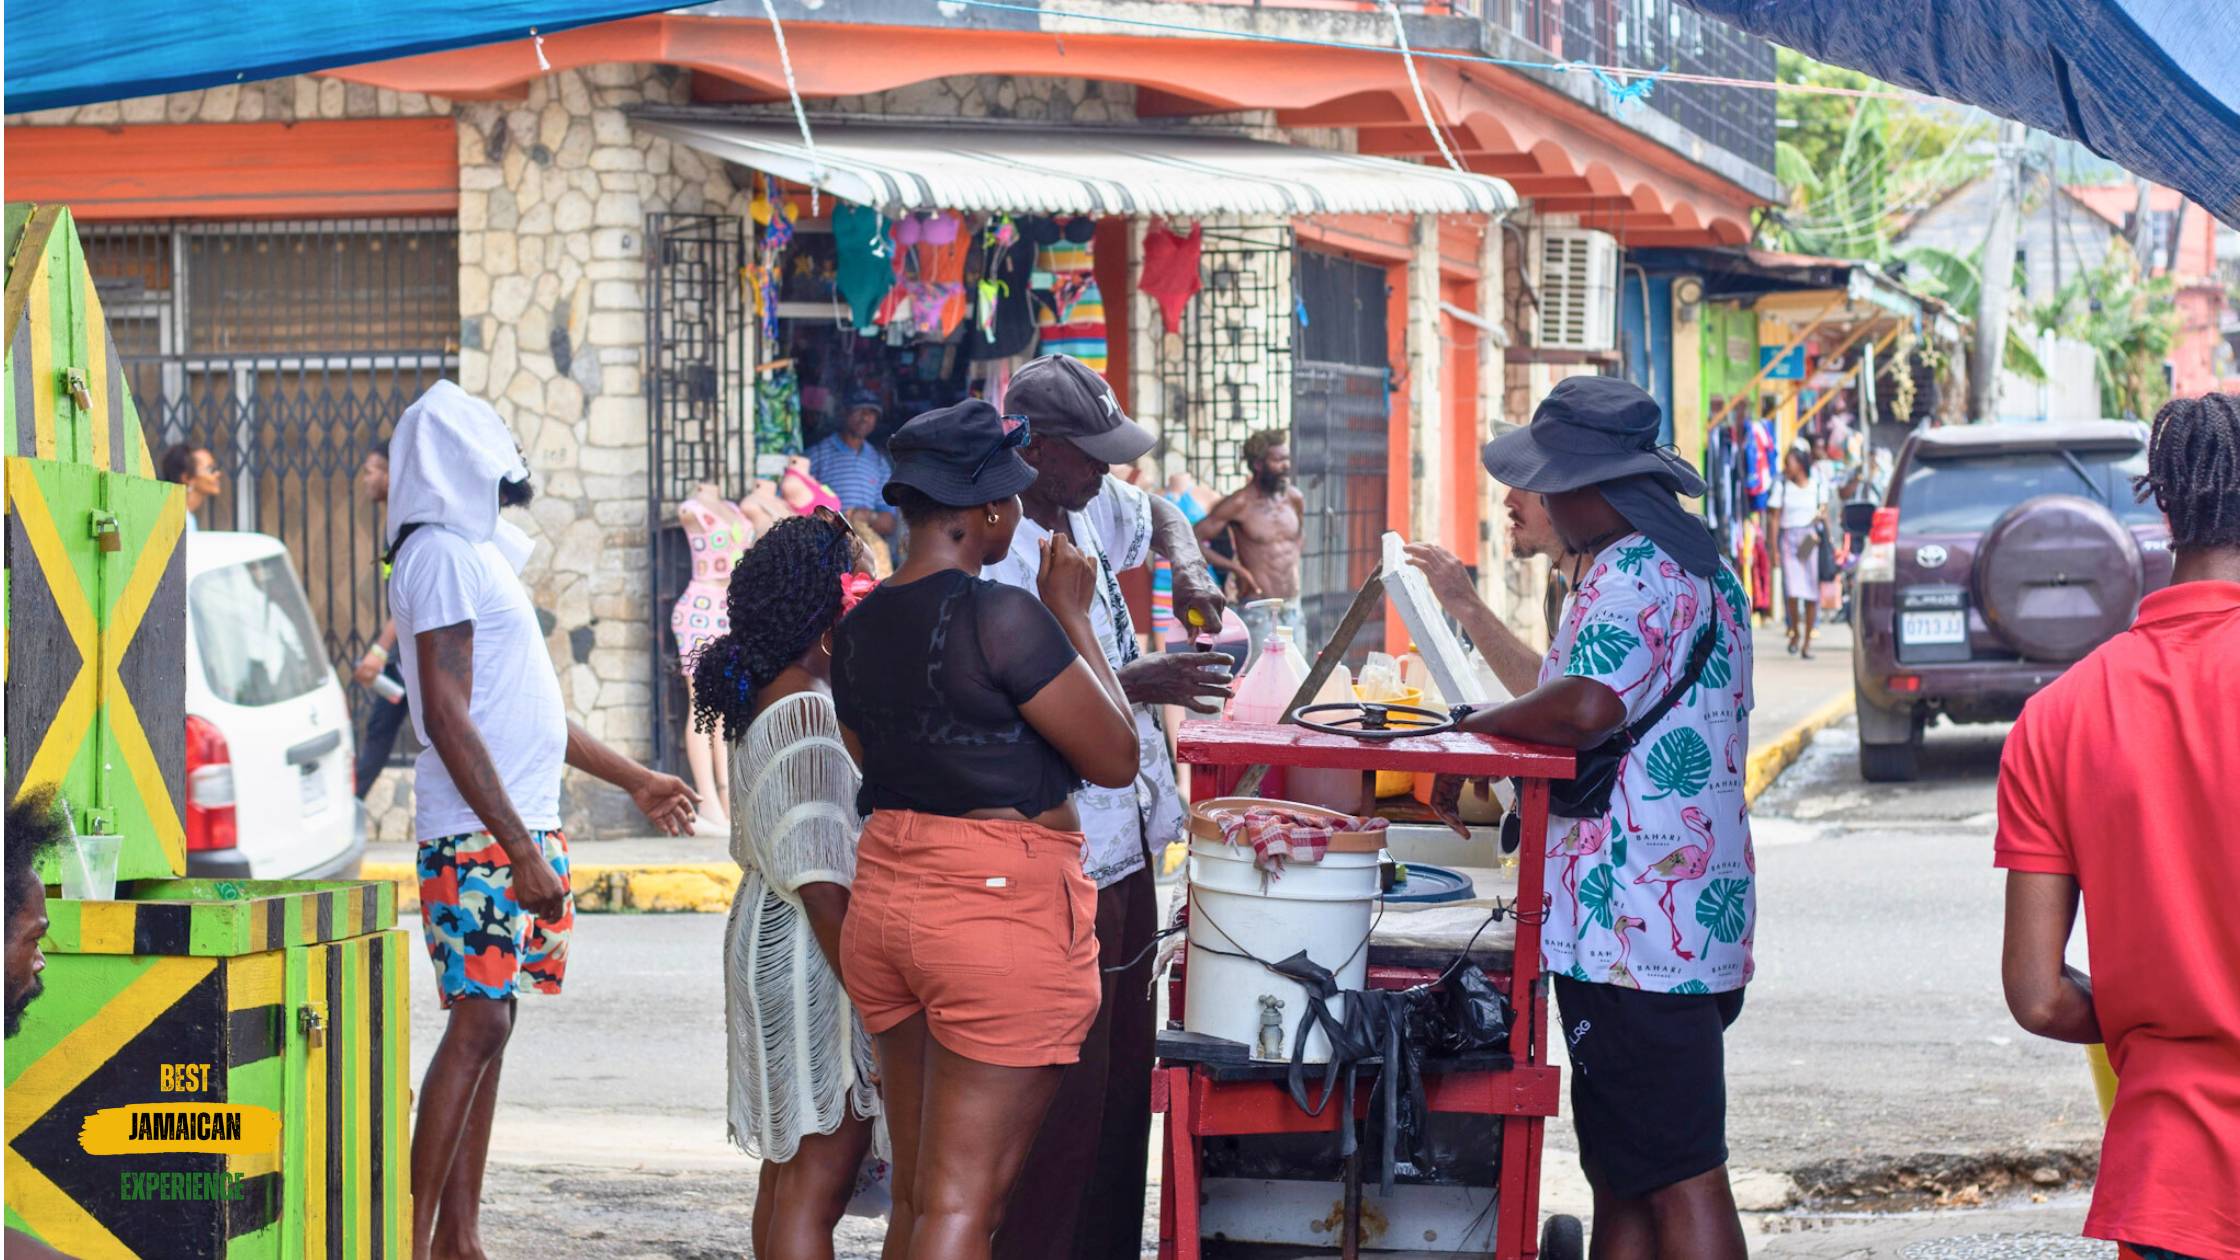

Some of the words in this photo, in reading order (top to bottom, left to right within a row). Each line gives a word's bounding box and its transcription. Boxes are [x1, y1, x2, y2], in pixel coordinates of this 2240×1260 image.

[1635, 833, 1681, 842] BAHARI
[1637, 965, 1682, 975] BAHARI
[1568, 1019, 1592, 1045] LRG
